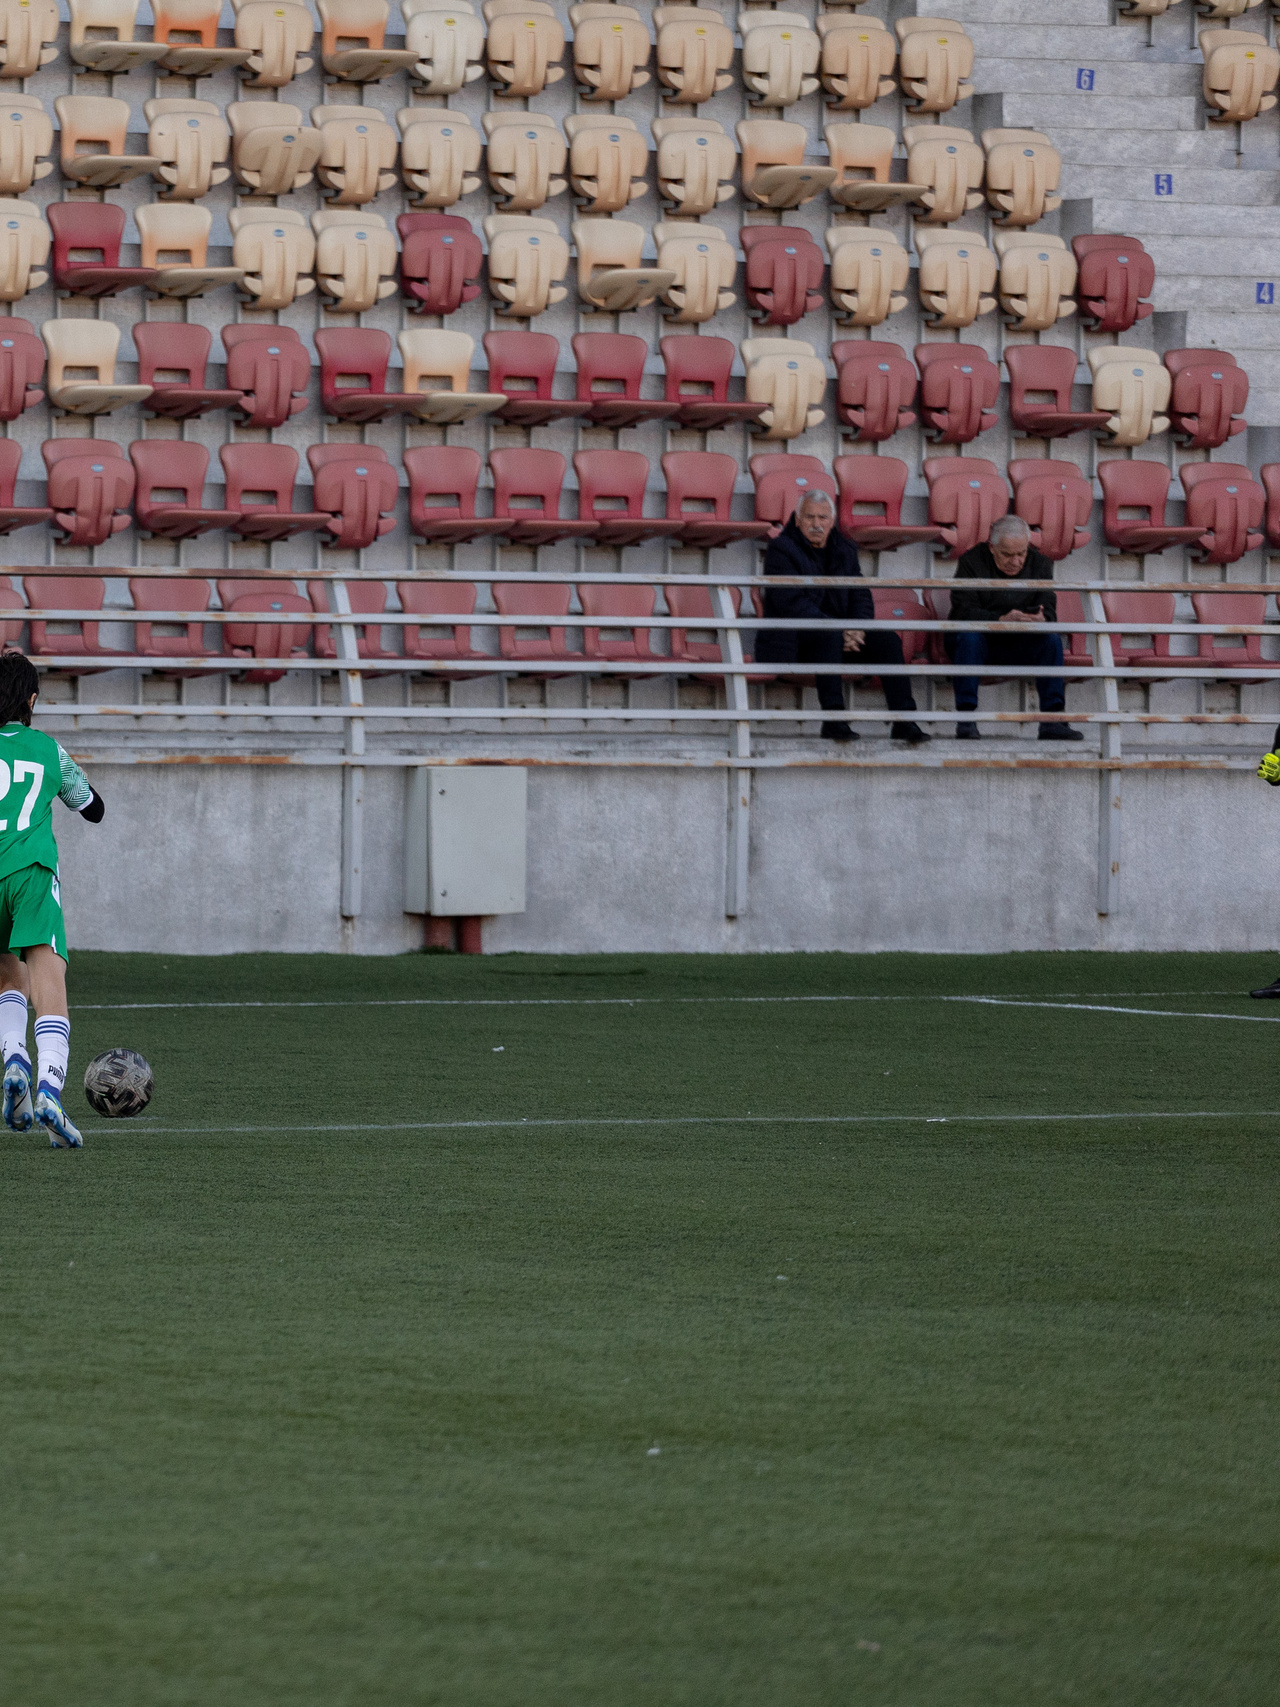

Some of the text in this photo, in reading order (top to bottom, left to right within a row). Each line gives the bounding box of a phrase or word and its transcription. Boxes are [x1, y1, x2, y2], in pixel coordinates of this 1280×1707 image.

[1080, 69, 1091, 90] 6
[1158, 175, 1169, 195] 5
[1260, 282, 1271, 304] 4
